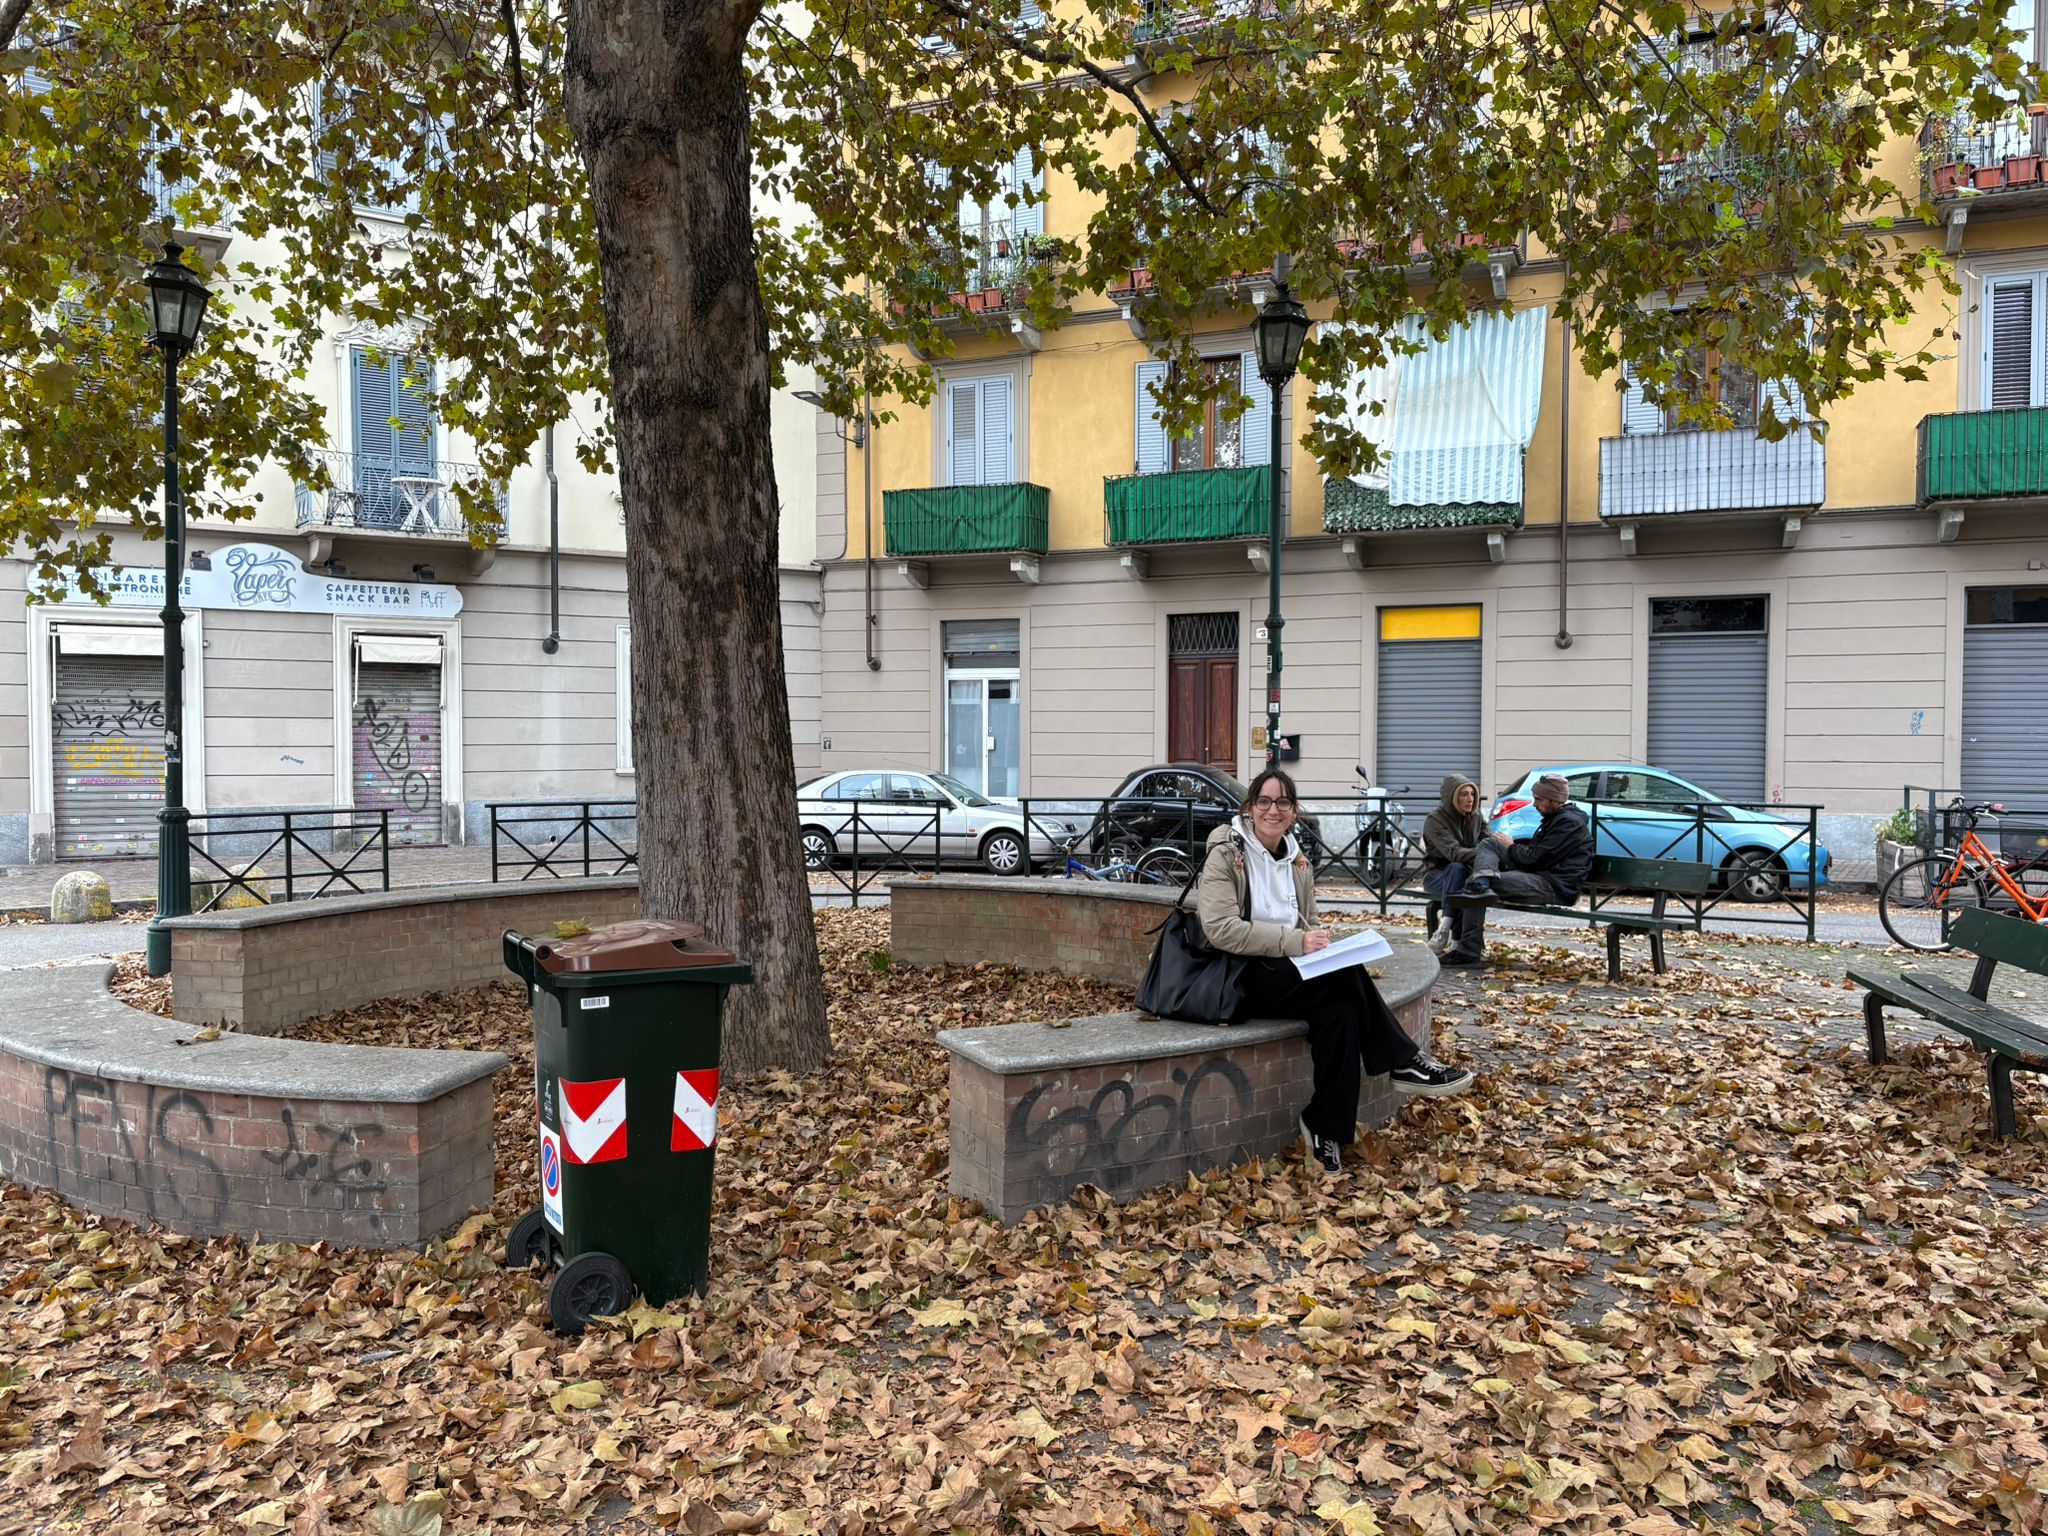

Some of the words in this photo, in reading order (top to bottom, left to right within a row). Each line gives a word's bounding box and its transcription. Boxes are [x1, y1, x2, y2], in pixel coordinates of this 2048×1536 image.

[92, 572, 191, 585] SIGAREE
[326, 583, 410, 596] CAFFETTERIA
[326, 592, 375, 603] SNACK
[383, 595, 410, 604] BAR
